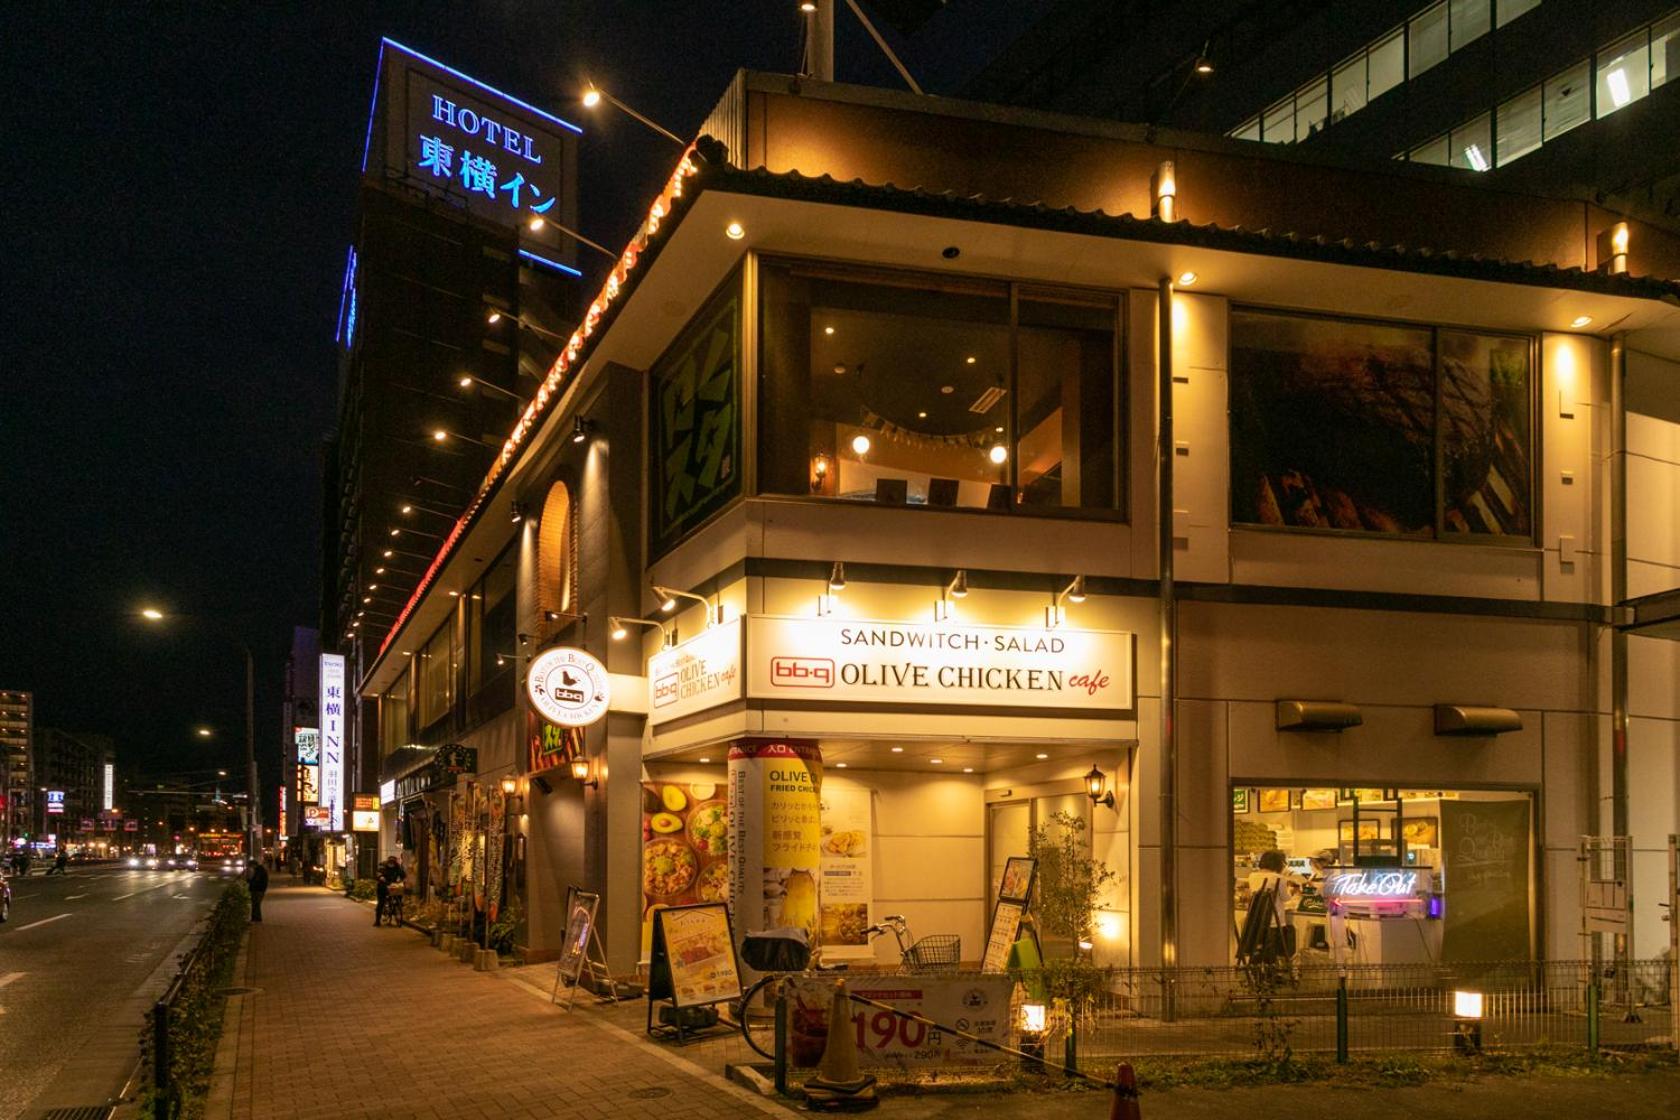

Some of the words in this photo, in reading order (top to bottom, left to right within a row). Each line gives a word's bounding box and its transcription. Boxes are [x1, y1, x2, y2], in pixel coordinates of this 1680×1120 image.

[432, 94, 542, 164] HOTEL
[417, 133, 556, 214] 東横イン
[680, 658, 707, 683] OLIVE
[840, 661, 930, 688] OLIVE
[937, 665, 1064, 692] CHICKEN
[1068, 669, 1112, 696] cafe
[680, 671, 721, 700] CHICKEN
[768, 744, 786, 754] 入口
[769, 770, 807, 782] OLIVE
[770, 784, 796, 793] FRIED
[1334, 872, 1376, 896] Take
[1377, 872, 1417, 896] Out
